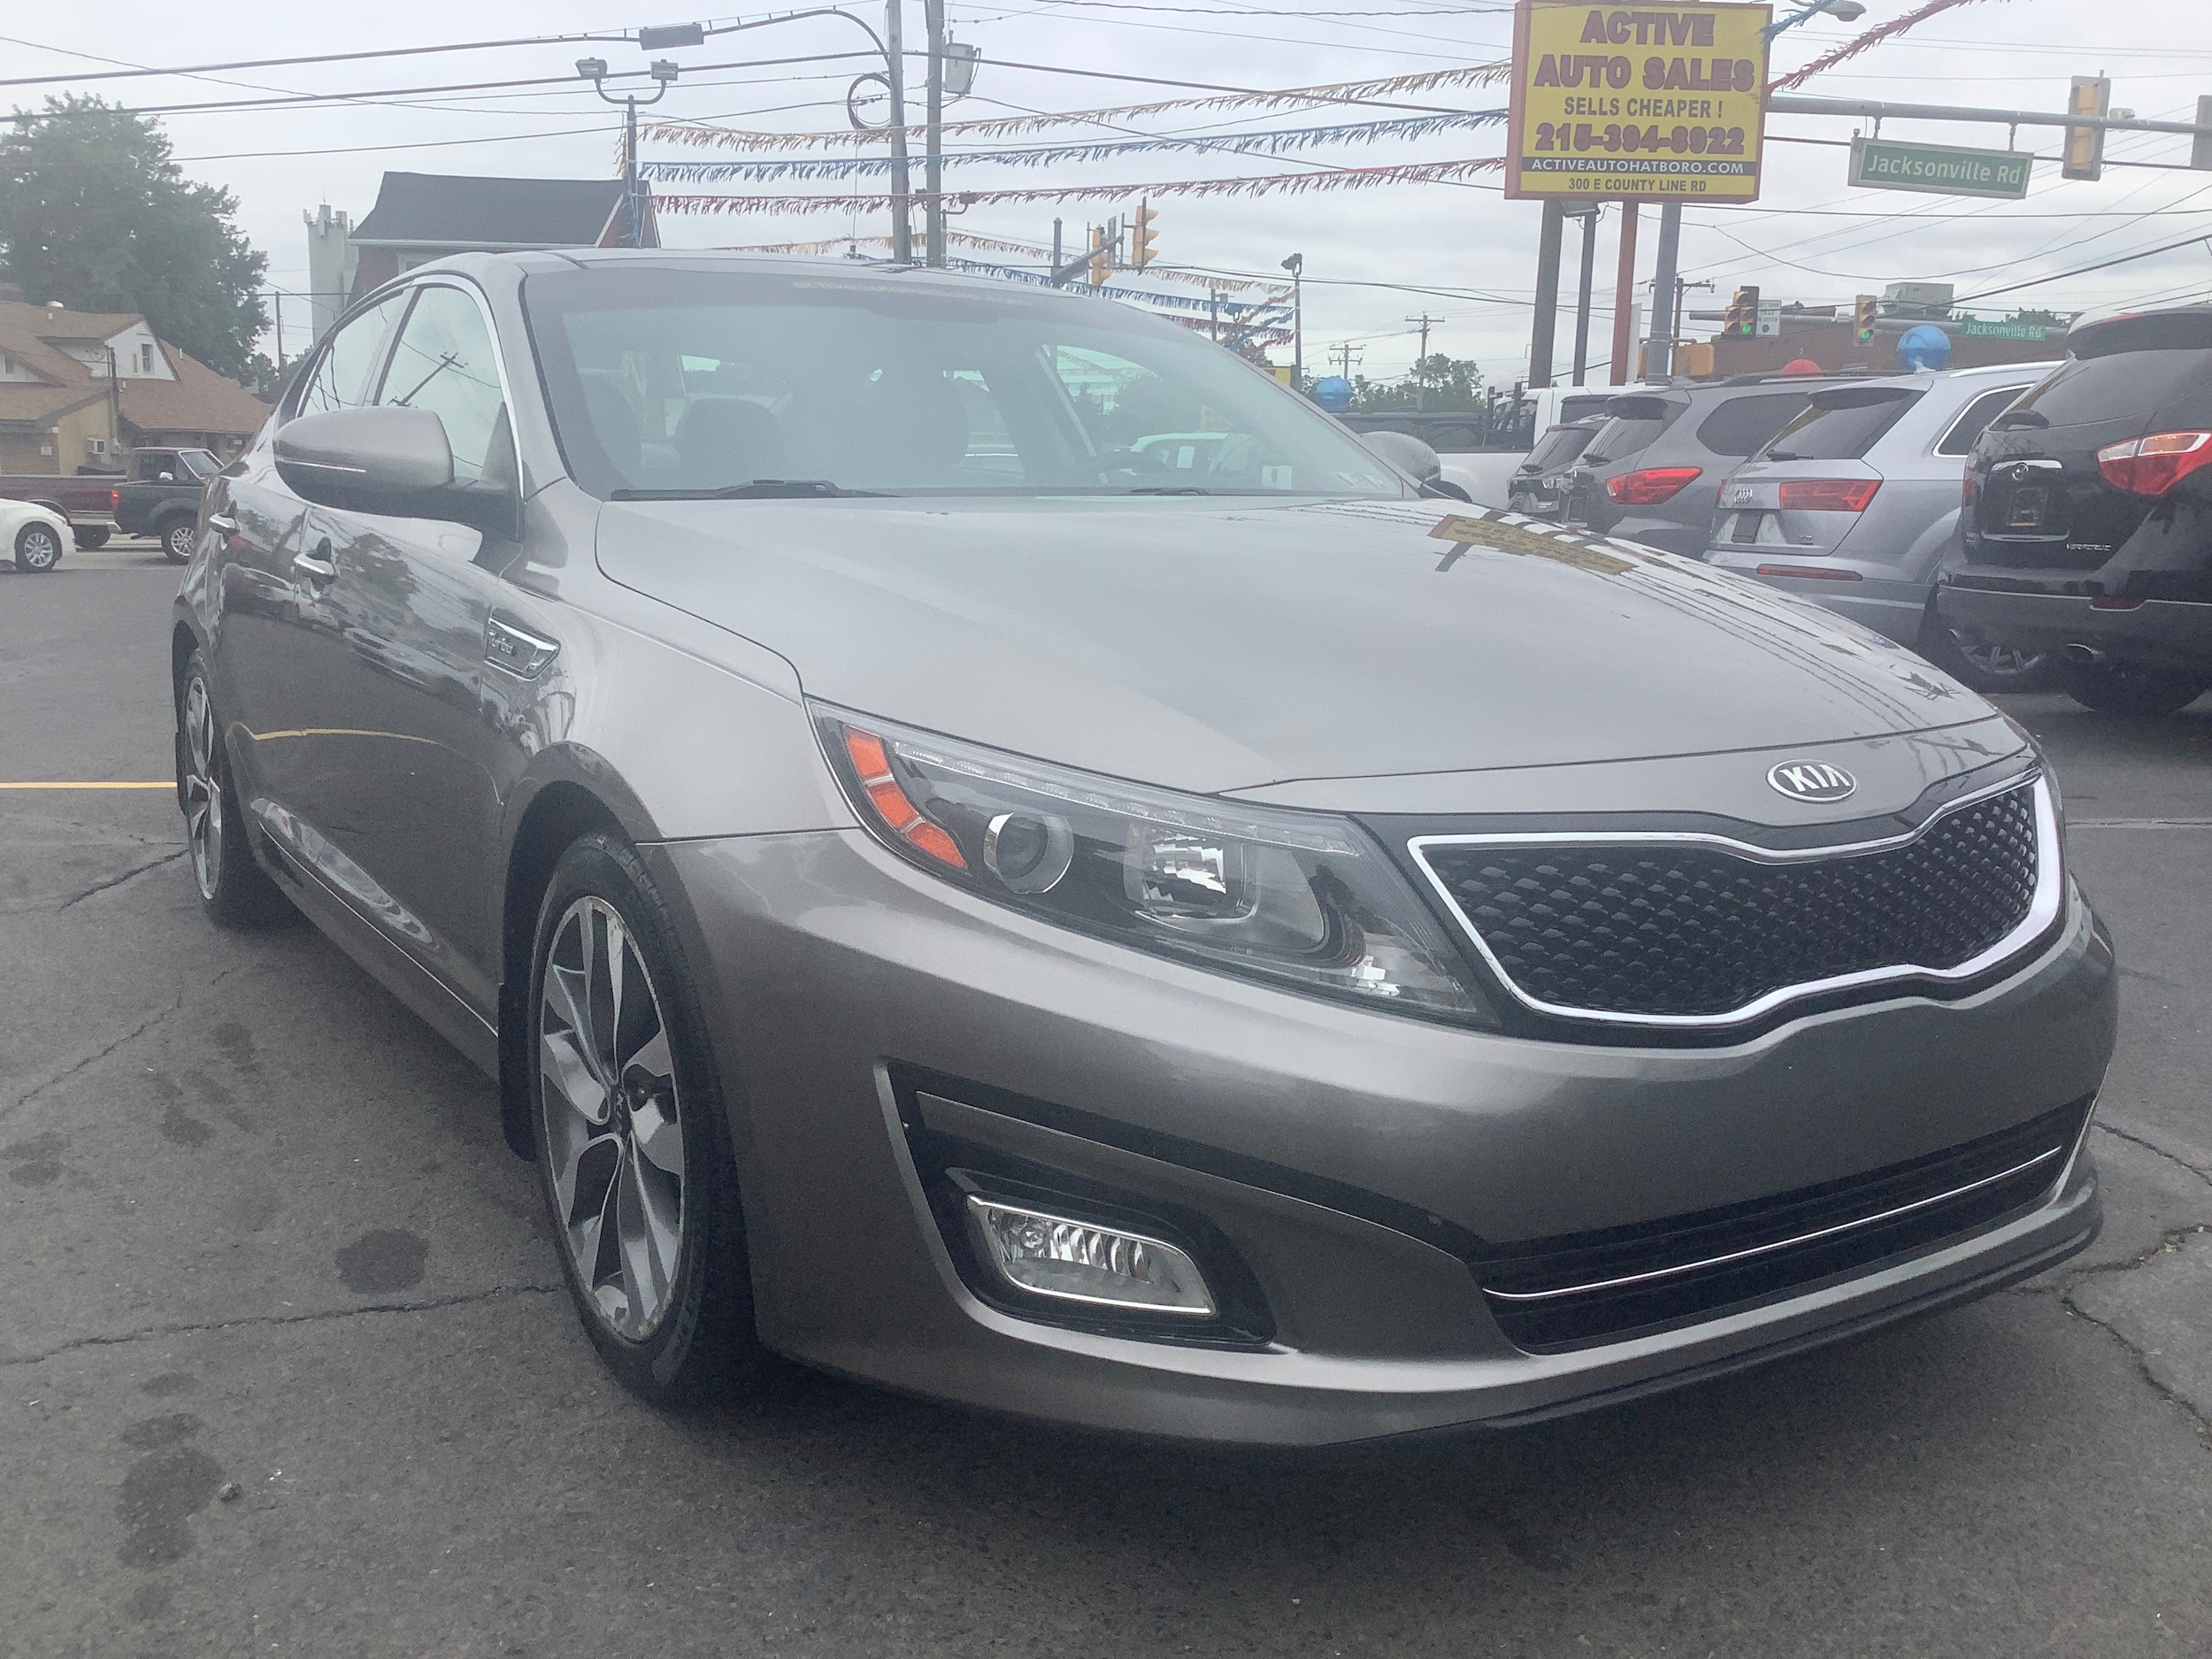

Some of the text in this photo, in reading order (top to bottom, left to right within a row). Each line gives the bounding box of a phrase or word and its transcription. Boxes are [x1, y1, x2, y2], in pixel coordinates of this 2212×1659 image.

[1579, 10, 1716, 47] ACTIVE
[1532, 54, 1755, 92] AUTO SALES
[1563, 96, 1619, 116] SELLS
[1626, 98, 1712, 119] CHEAPER
[1531, 157, 1744, 174] ACTIVEAUTOHATBORO.COM
[1868, 154, 2022, 185] Jacksonville Rd
[1569, 178, 1707, 192] 300 E COUNTY LINE RD
[1965, 322, 2042, 338] Jacksonville Rd
[1778, 764, 1851, 792] KIA
